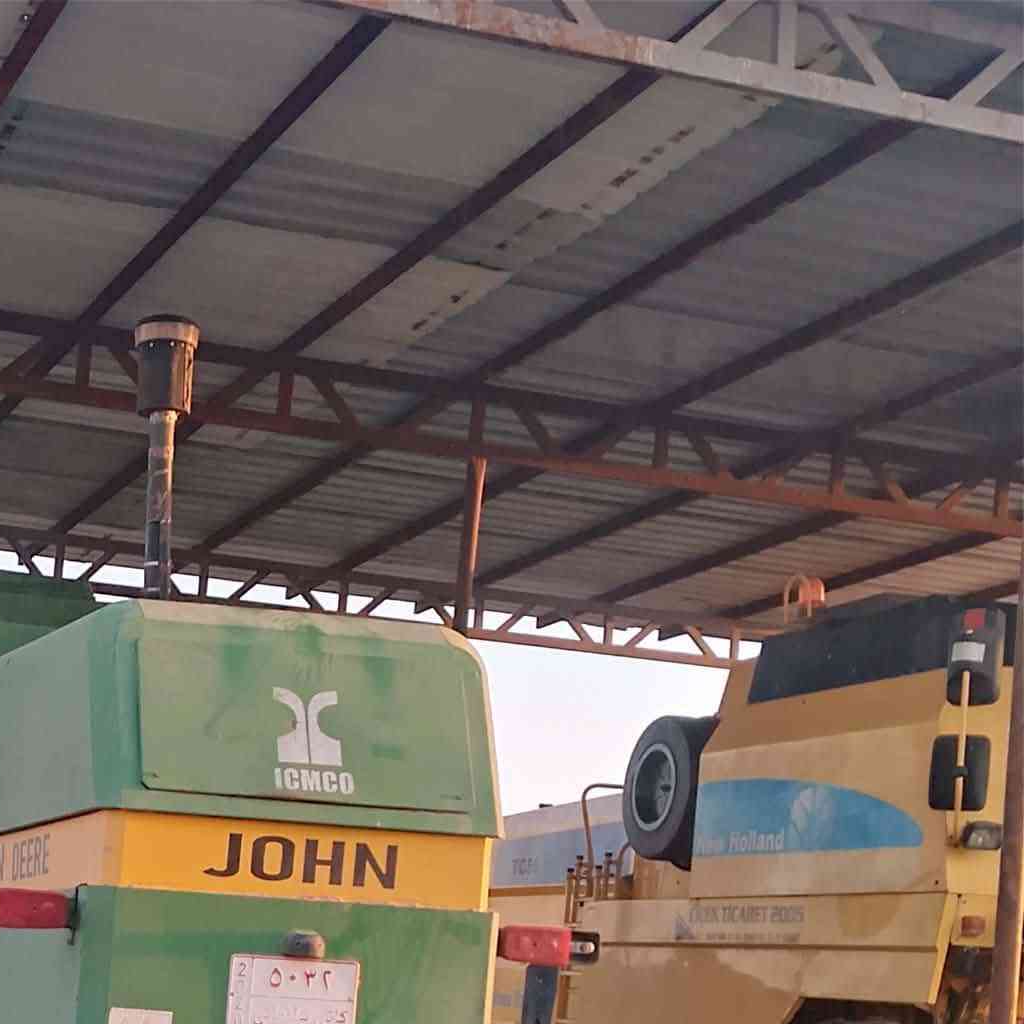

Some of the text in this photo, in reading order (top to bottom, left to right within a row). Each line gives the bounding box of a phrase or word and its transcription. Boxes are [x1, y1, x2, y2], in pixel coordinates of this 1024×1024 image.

[274, 767, 355, 795] ICMCO
[12, 833, 50, 881] DEERE
[728, 828, 785, 854] Holland
[202, 832, 400, 890] JOHN
